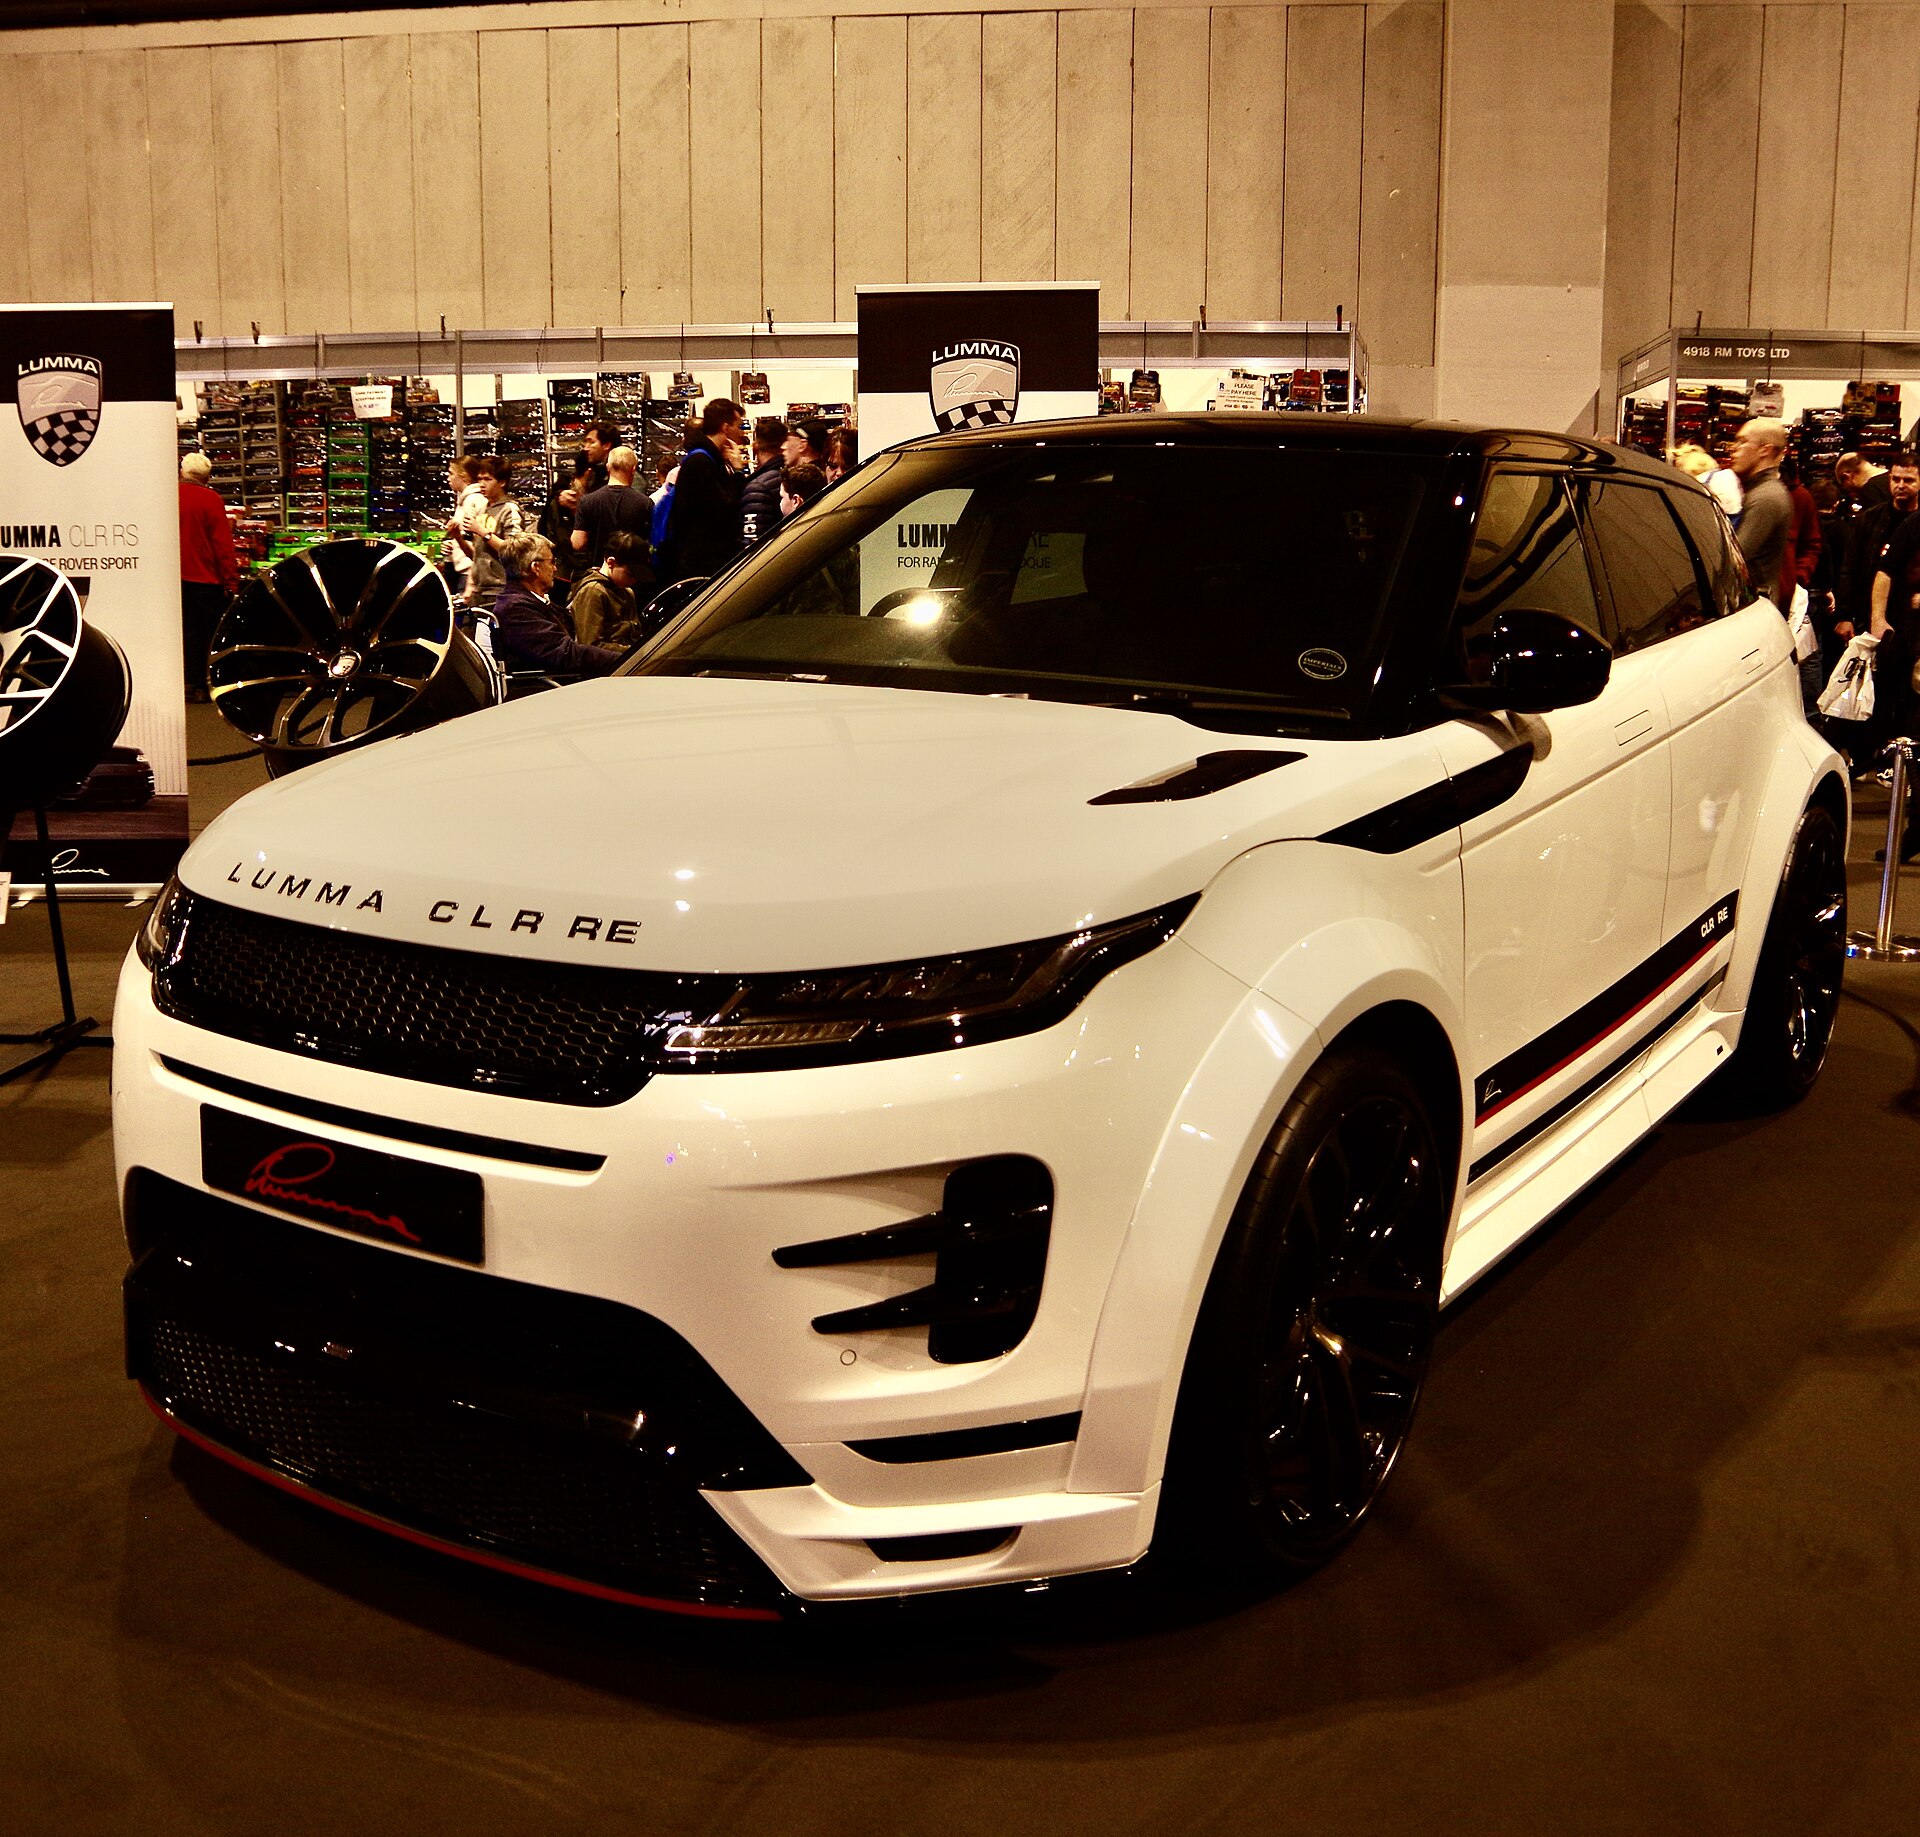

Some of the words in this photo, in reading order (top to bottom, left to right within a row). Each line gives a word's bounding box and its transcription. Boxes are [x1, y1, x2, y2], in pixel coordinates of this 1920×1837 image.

[933, 343, 1016, 363] LUMMA
[1683, 346, 1710, 357] 4918
[1714, 347, 1732, 357] RM
[1737, 347, 1766, 358] TOYS
[1770, 348, 1790, 359] LTD
[18, 356, 98, 376] LUMMA
[0, 525, 61, 548] UMMA
[69, 524, 108, 547] CLR
[113, 524, 138, 546] RS
[898, 524, 957, 548] LUMM
[60, 558, 98, 570] ROVER
[101, 557, 139, 570] SPORT
[898, 556, 921, 568] FOR
[227, 862, 384, 913] LUMMA
[428, 900, 545, 934] CLR
[567, 915, 642, 944] RE
[1701, 917, 1715, 937] CLR
[1717, 906, 1728, 924] RE
